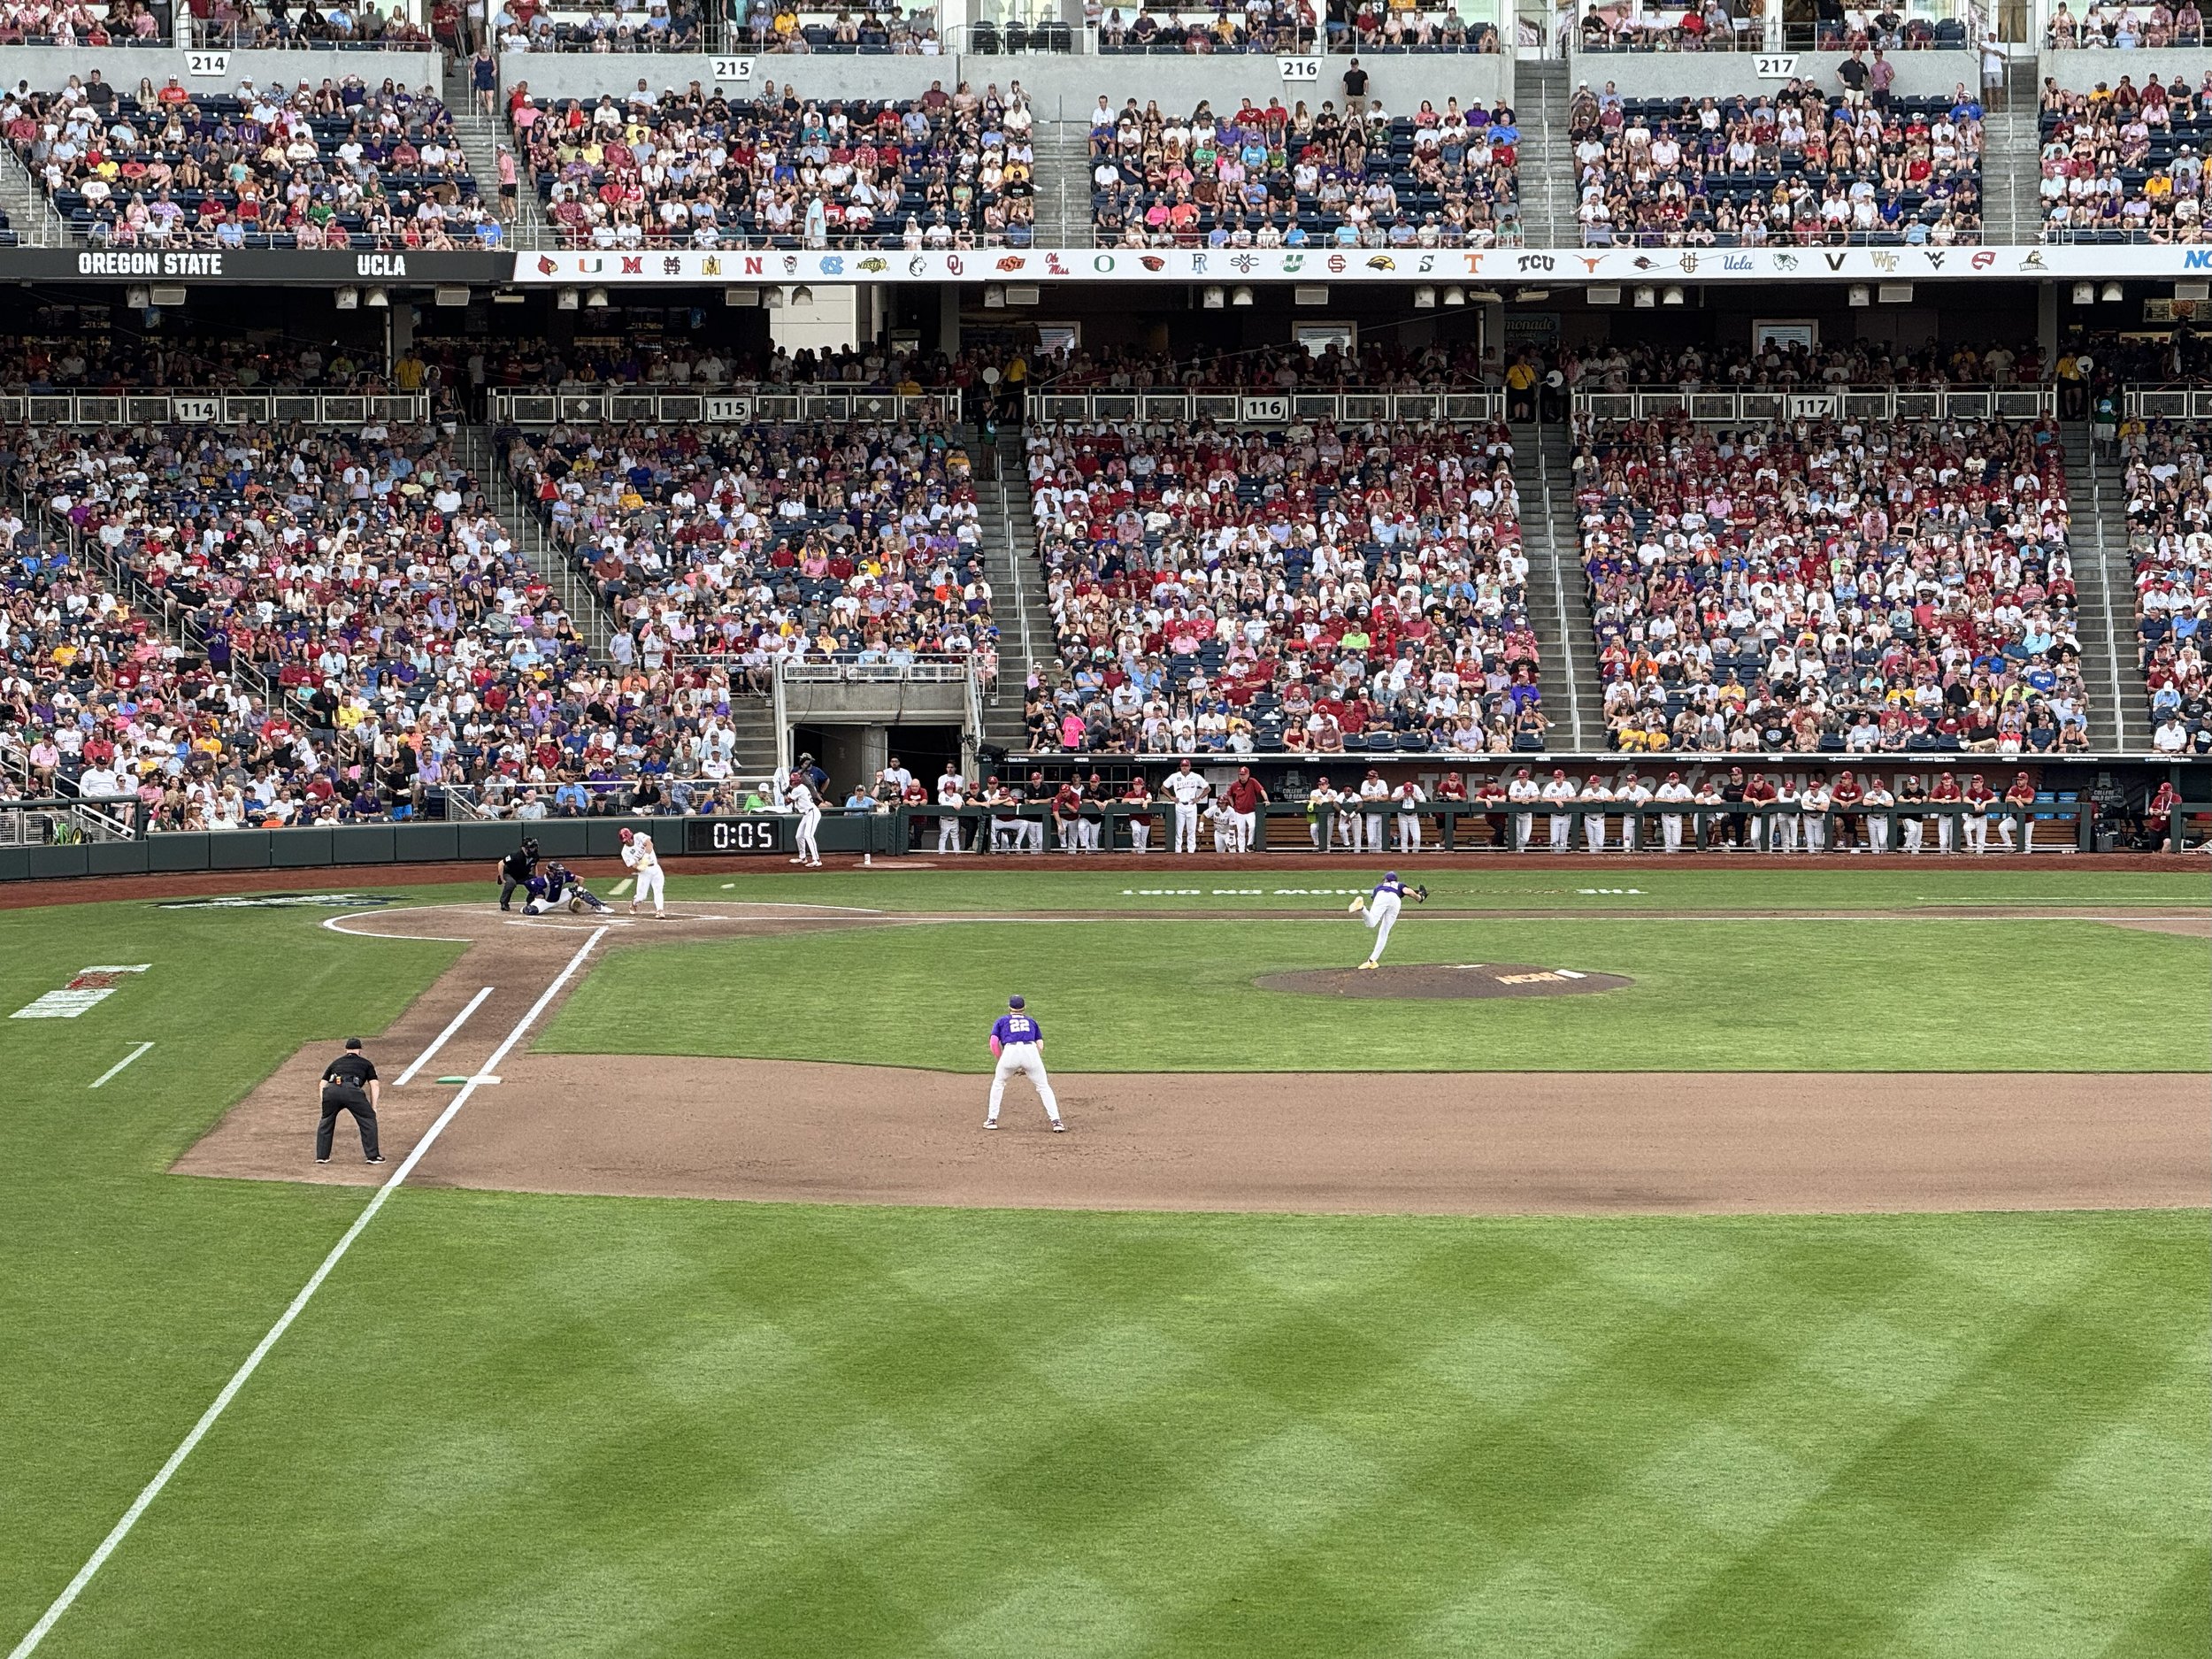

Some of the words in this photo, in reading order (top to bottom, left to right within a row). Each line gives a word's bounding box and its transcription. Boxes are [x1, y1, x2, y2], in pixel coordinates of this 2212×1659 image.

[192, 57, 225, 70] 214
[717, 61, 749, 75] 215
[1284, 62, 1317, 75] 216
[1759, 59, 1793, 73] 217
[78, 252, 158, 274] OREGON
[164, 252, 222, 275] STATE
[357, 254, 406, 276] UCLA
[744, 256, 764, 275] N
[1517, 254, 1555, 273] TCU
[1723, 254, 1754, 271] Ucla
[180, 403, 213, 417] 114
[713, 402, 745, 416] 115
[1249, 401, 1281, 415] 116
[1797, 399, 1828, 414] 117
[712, 822, 772, 849] 0:05
[1009, 1018, 1031, 1033] 22
